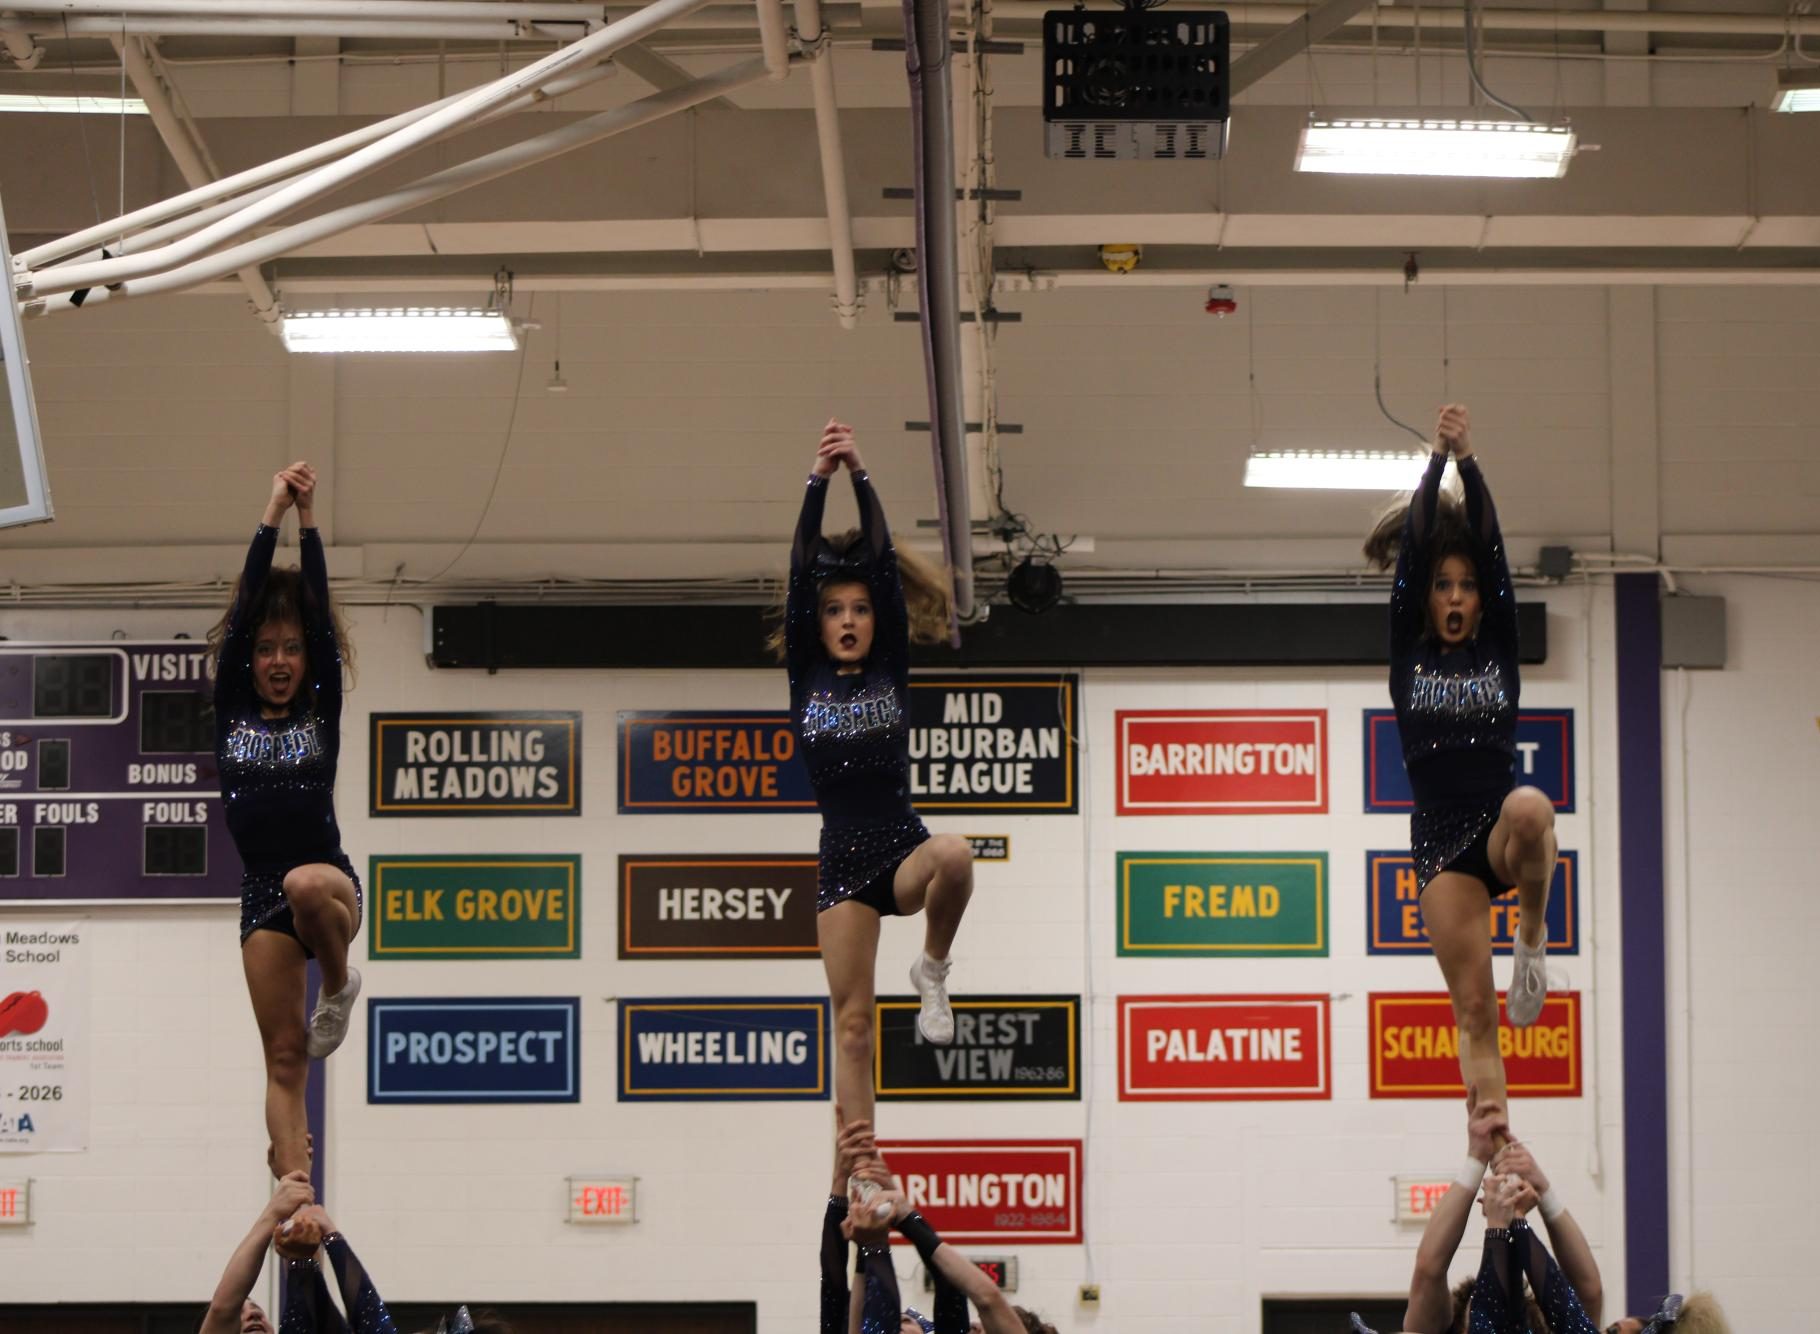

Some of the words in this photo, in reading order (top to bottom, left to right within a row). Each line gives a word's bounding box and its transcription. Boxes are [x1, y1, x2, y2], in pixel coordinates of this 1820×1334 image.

[943, 693, 1002, 723] MID
[230, 726, 320, 762] PROSPECT
[406, 730, 545, 763] ROLLING
[652, 729, 795, 762] BUFFALO
[1129, 743, 1315, 776] BARRINGTON
[127, 764, 197, 784] BONUS
[394, 766, 560, 800] MEADOWS
[671, 766, 778, 797] GROVE
[910, 763, 1033, 794] LEAGUE
[34, 803, 99, 824] FOULS
[143, 802, 208, 824] FOULS
[386, 889, 444, 921] ELK
[455, 888, 564, 921] GROVE
[658, 888, 792, 921] HERSEY
[1164, 885, 1280, 918] FREMD
[6, 931, 80, 944] Meadows
[6, 950, 60, 963] School
[26, 1039, 64, 1052] school
[386, 1031, 562, 1064] PROSPECT
[637, 1031, 808, 1064] WHEELING
[1147, 1028, 1302, 1062] PALATINE
[935, 1049, 1014, 1080] VIEW
[19, 1085, 63, 1101] 2026
[583, 1186, 624, 1216] EXIT
